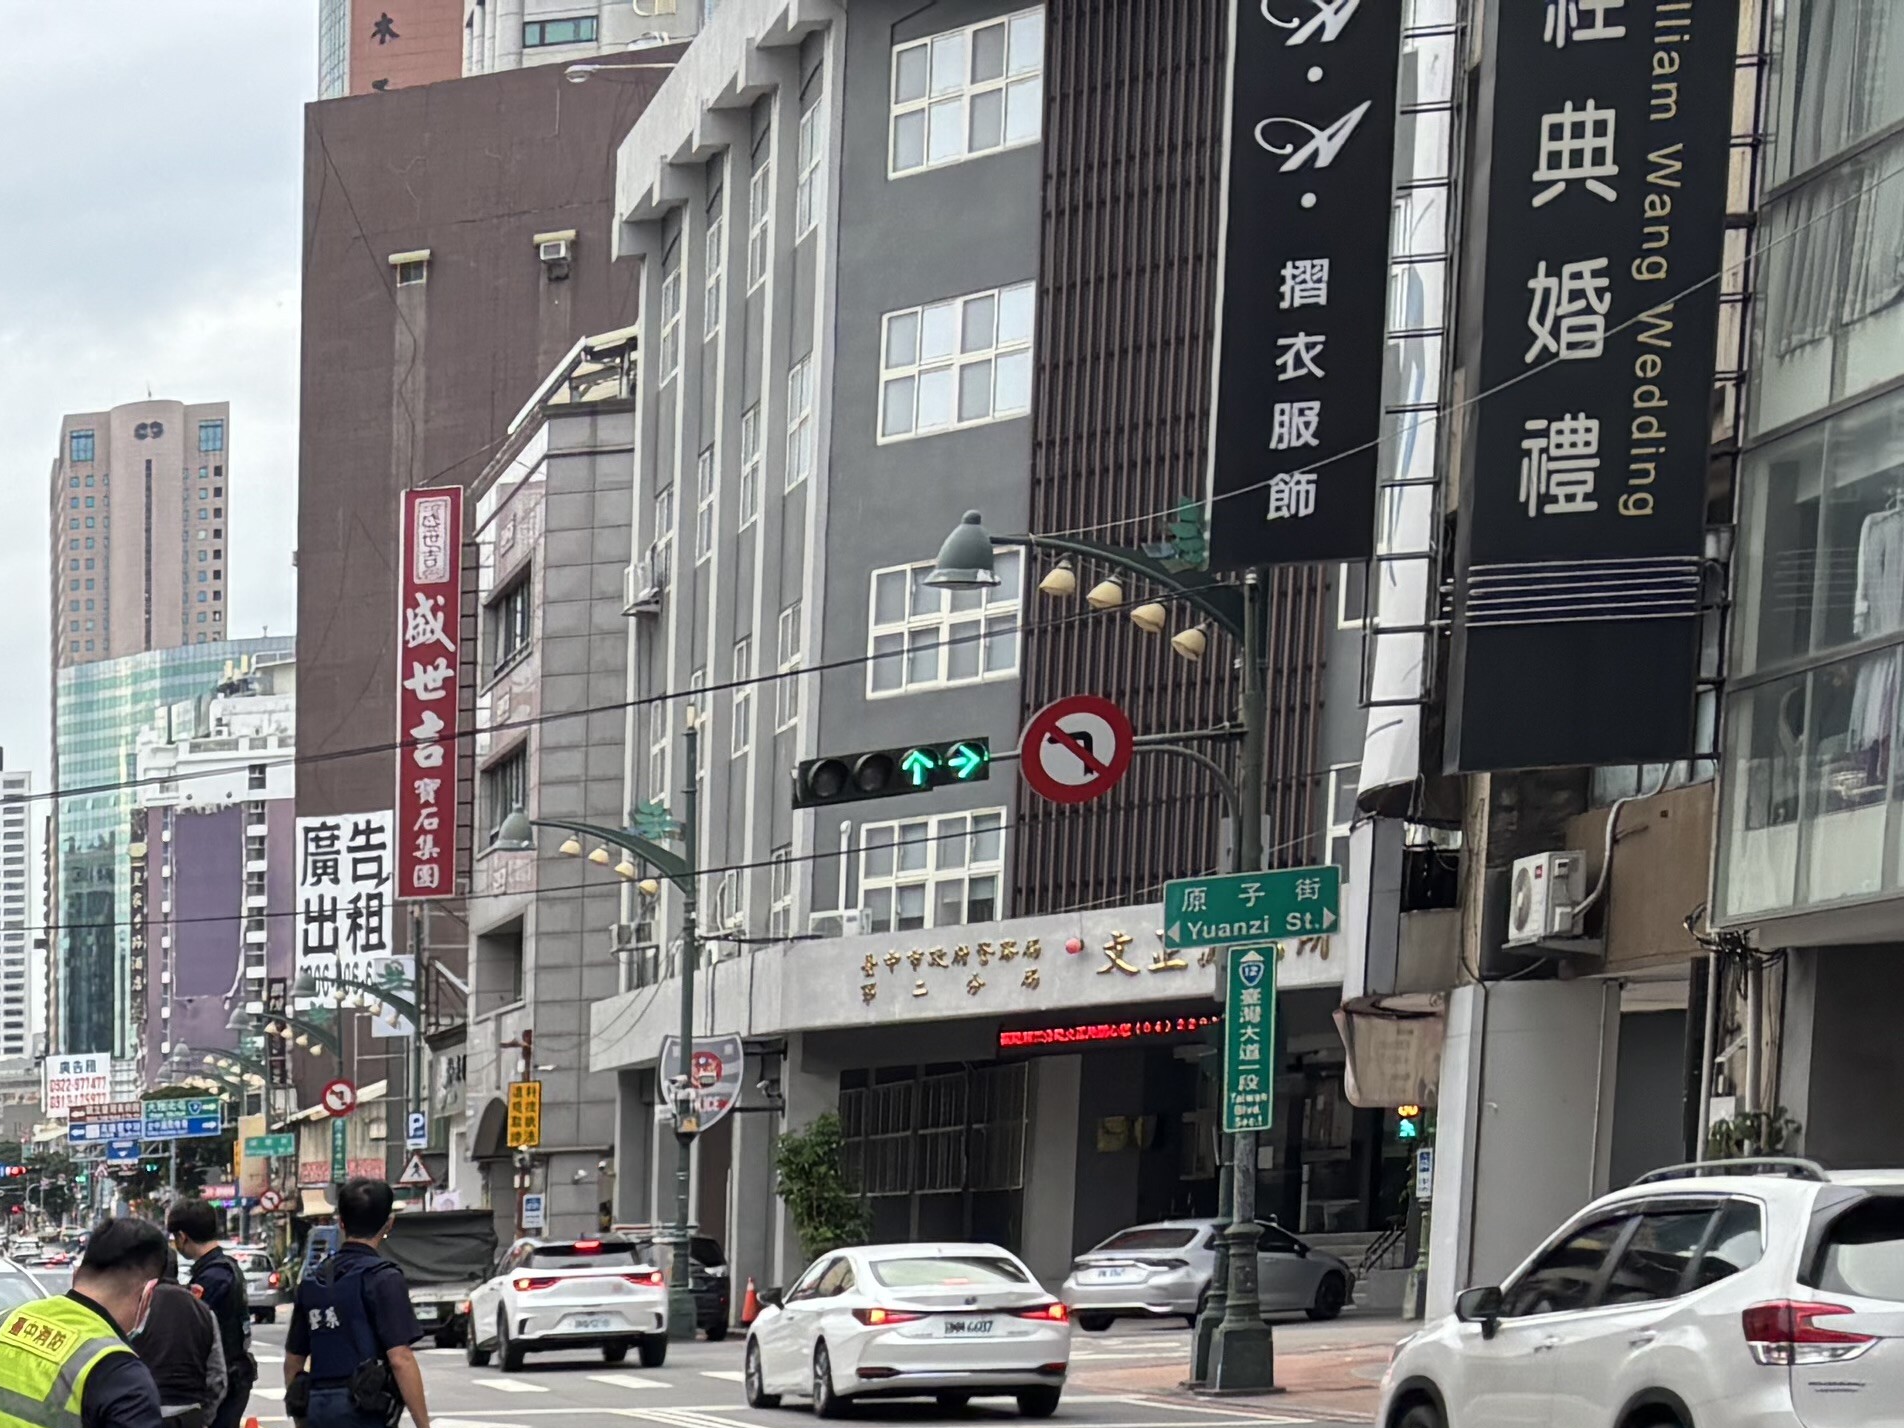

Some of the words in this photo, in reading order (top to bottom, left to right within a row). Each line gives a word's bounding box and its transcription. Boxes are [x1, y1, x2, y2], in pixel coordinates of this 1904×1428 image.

[1631, 142, 1684, 280] Wang
[1266, 258, 1330, 521] 摺衣服飾
[1618, 303, 1676, 516] Wedding
[301, 818, 387, 888] 廣告
[301, 892, 386, 956] 出租
[1182, 877, 1321, 912] 原子街
[1188, 915, 1269, 940] Yuanzi
[1286, 911, 1320, 932] St.
[1238, 987, 1262, 1091] 臺灣大道一段
[409, 1113, 424, 1136] P
